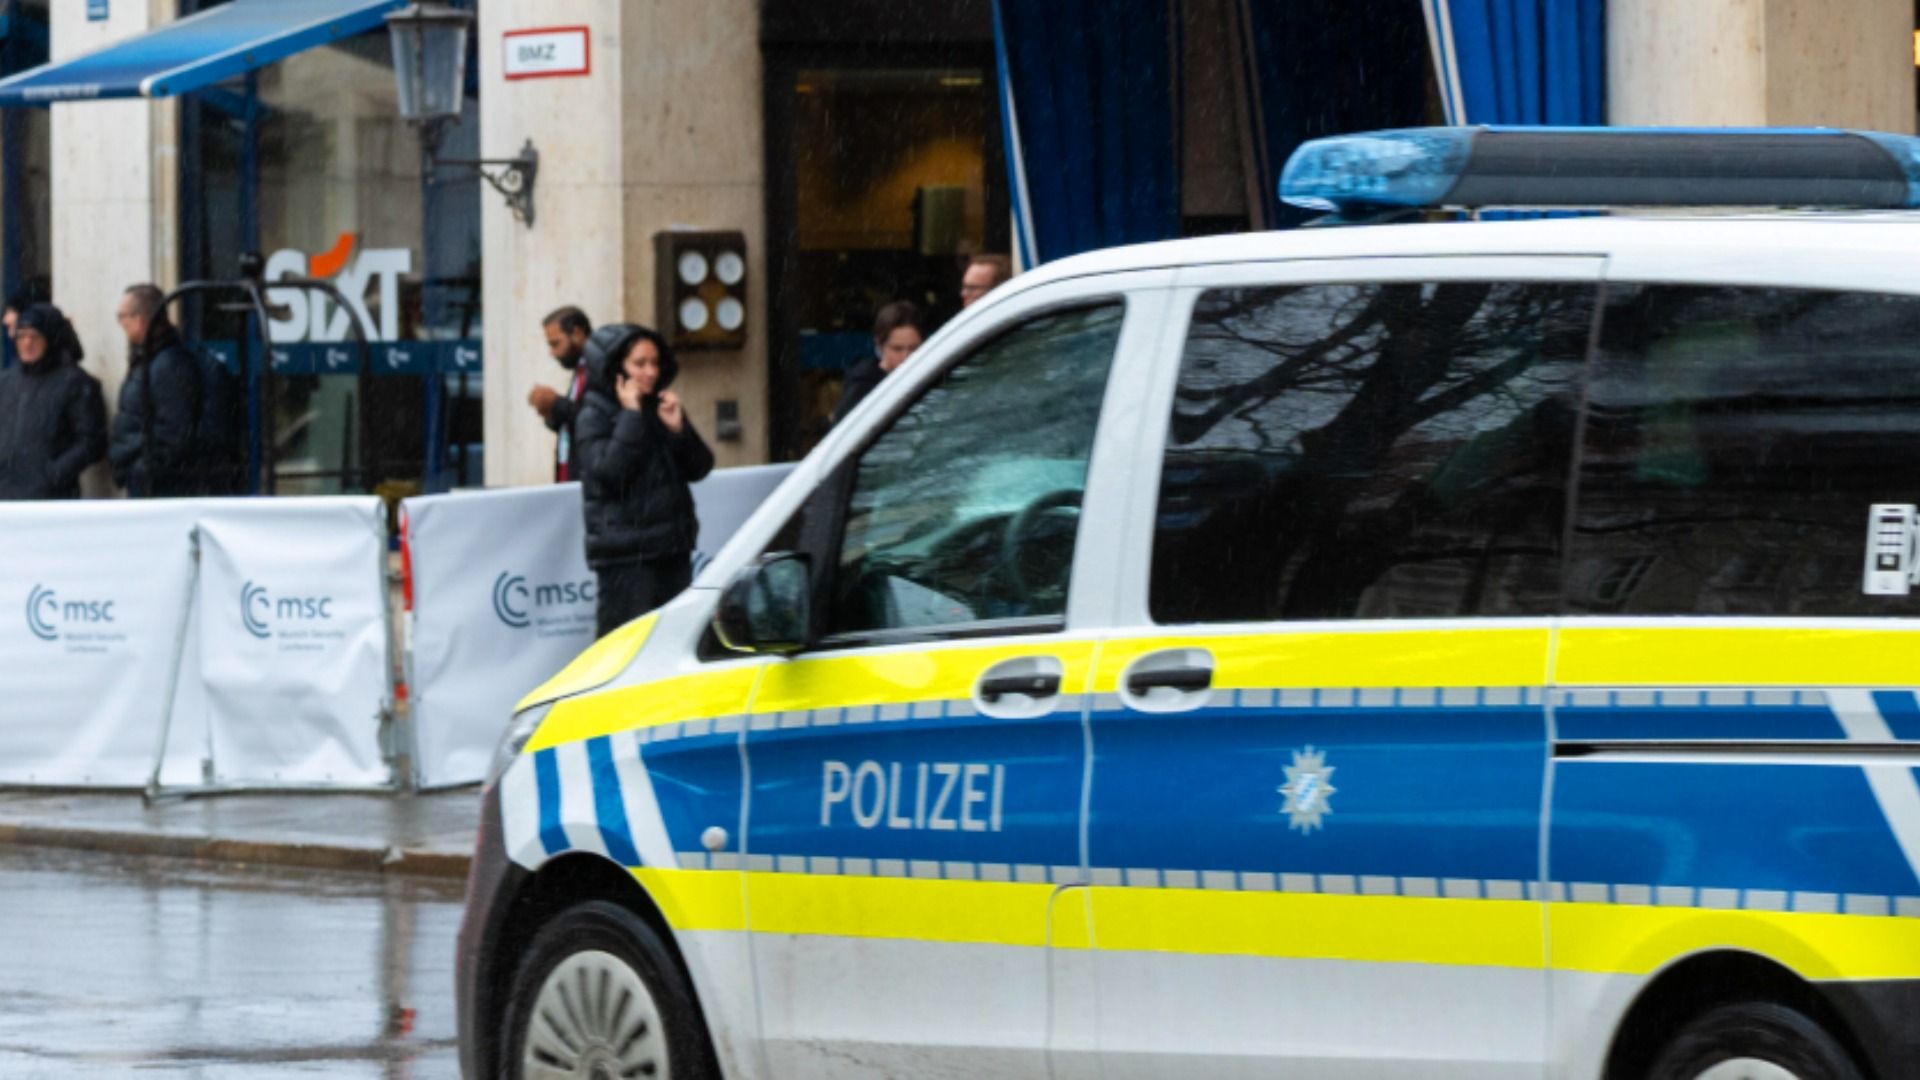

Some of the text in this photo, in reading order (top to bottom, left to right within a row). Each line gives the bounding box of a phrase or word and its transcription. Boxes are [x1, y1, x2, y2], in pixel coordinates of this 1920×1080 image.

[264, 232, 411, 344] SIXT
[536, 579, 595, 606] msc
[63, 600, 115, 622] msc
[277, 596, 332, 619] msc
[820, 759, 1005, 832] POLIZEI
